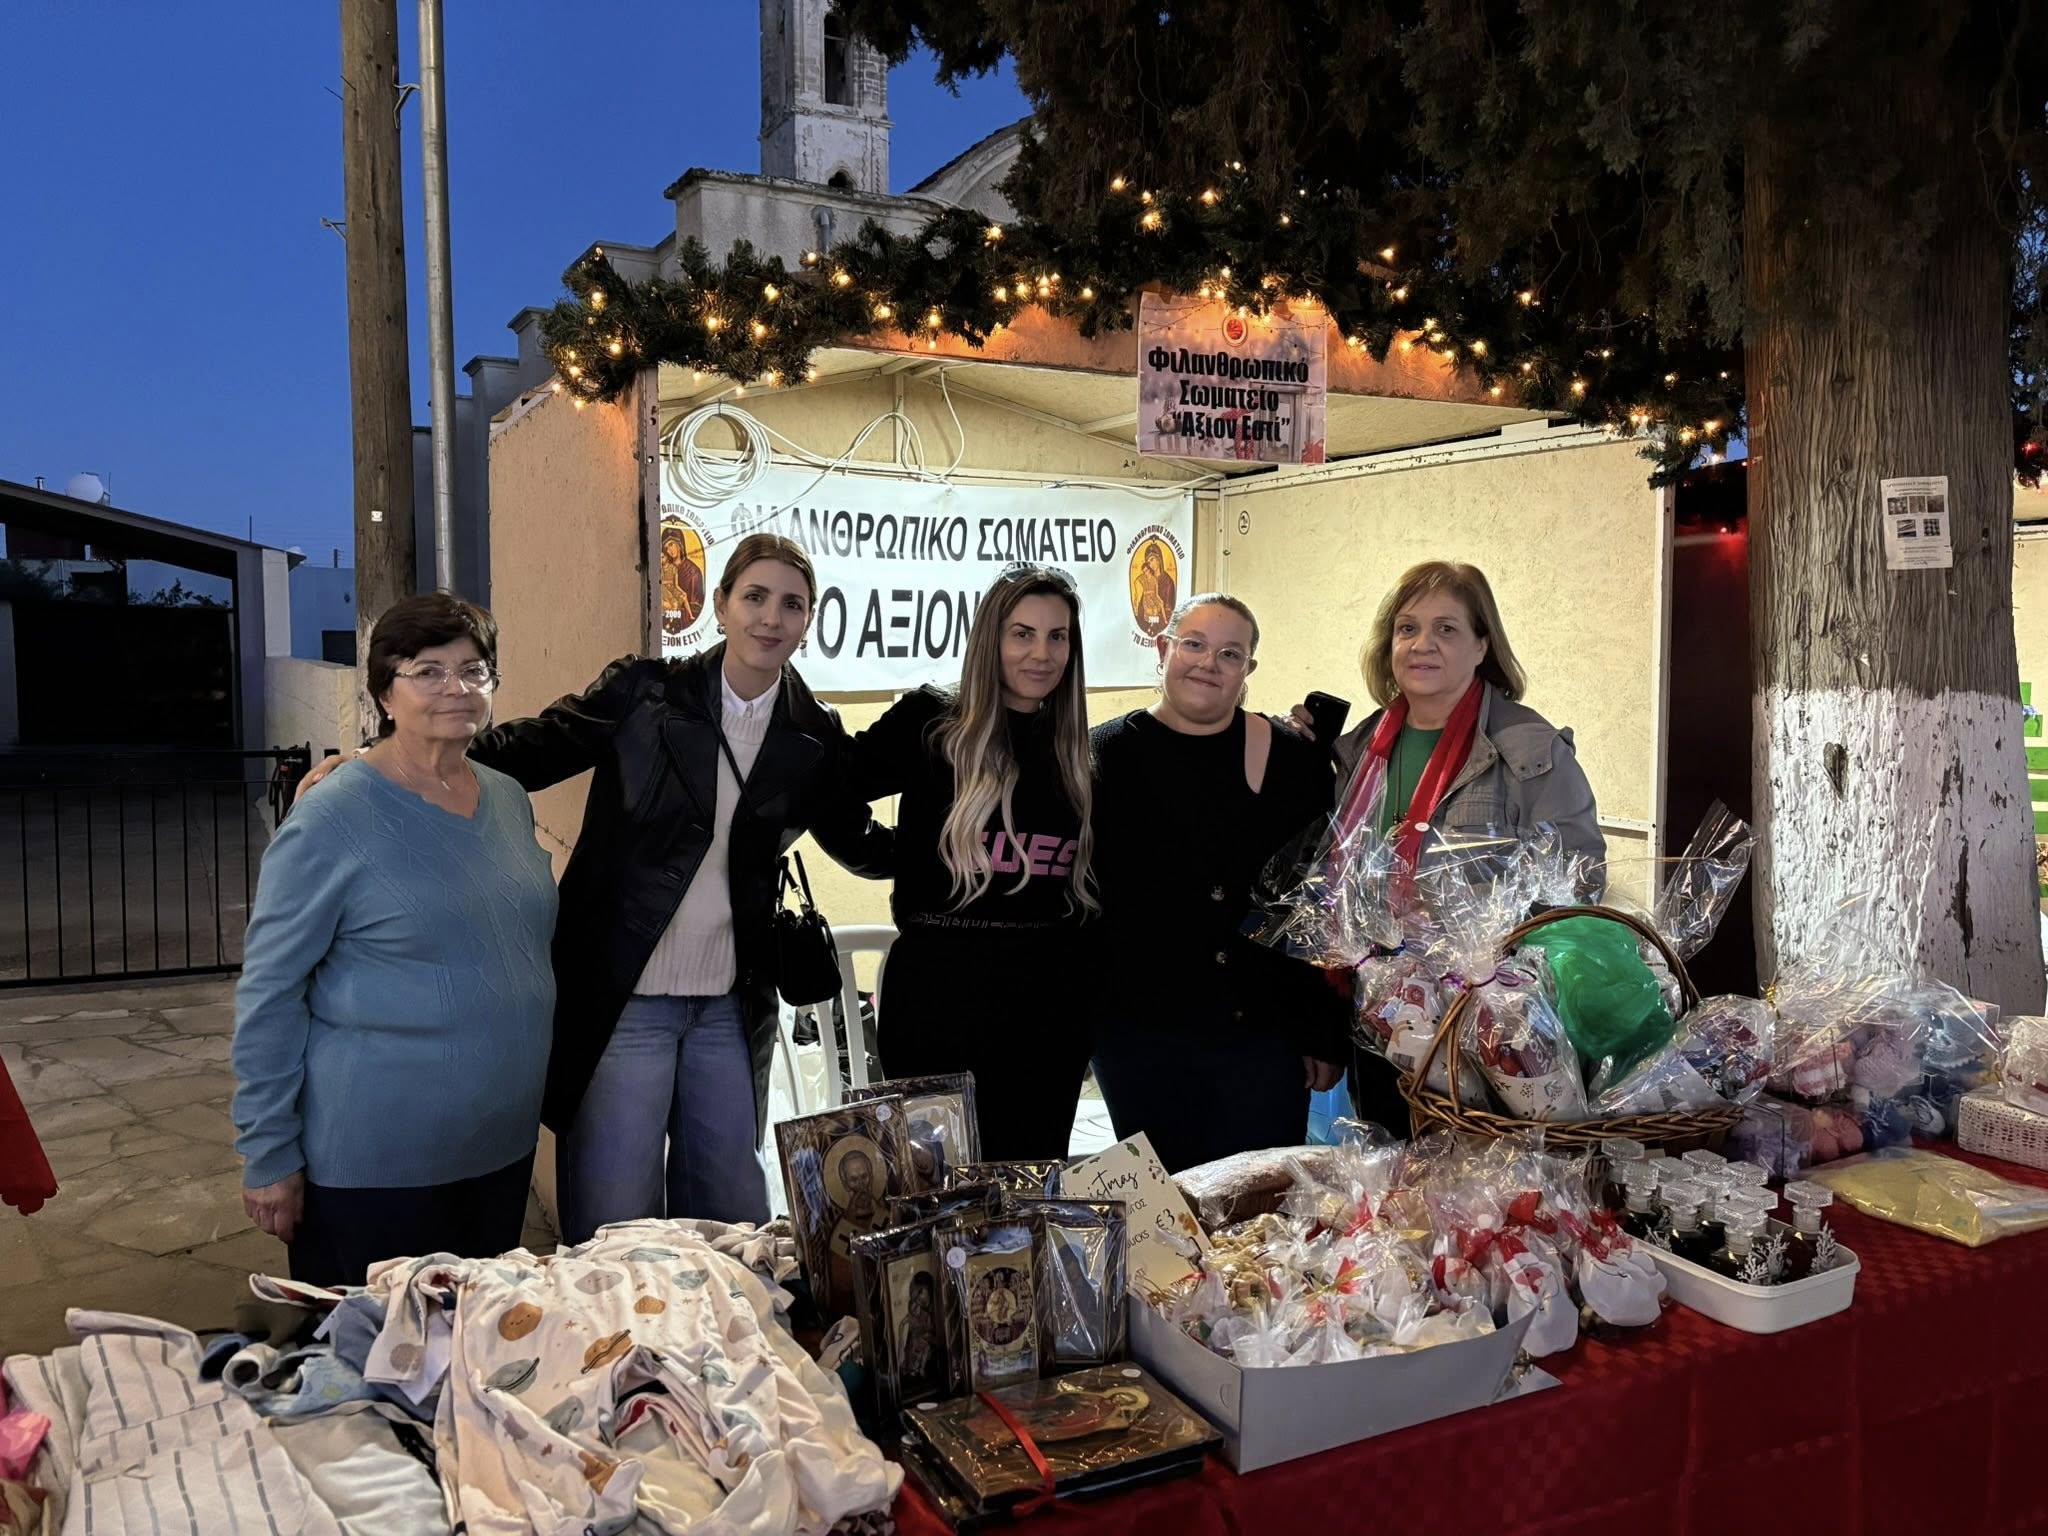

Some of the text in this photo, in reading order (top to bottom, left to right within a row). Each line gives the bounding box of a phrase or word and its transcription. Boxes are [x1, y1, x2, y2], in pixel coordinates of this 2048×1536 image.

[1148, 346, 1310, 383] Φιλανθρωπικό
[1178, 379, 1279, 412] Σωματείο
[730, 502, 1117, 563] ΦΙΛΑΝΘΡΩΠΙΚΟ ΣΩΜΑΤΕΙΟ
[856, 588, 981, 660] ΑΞΙΟΝ
